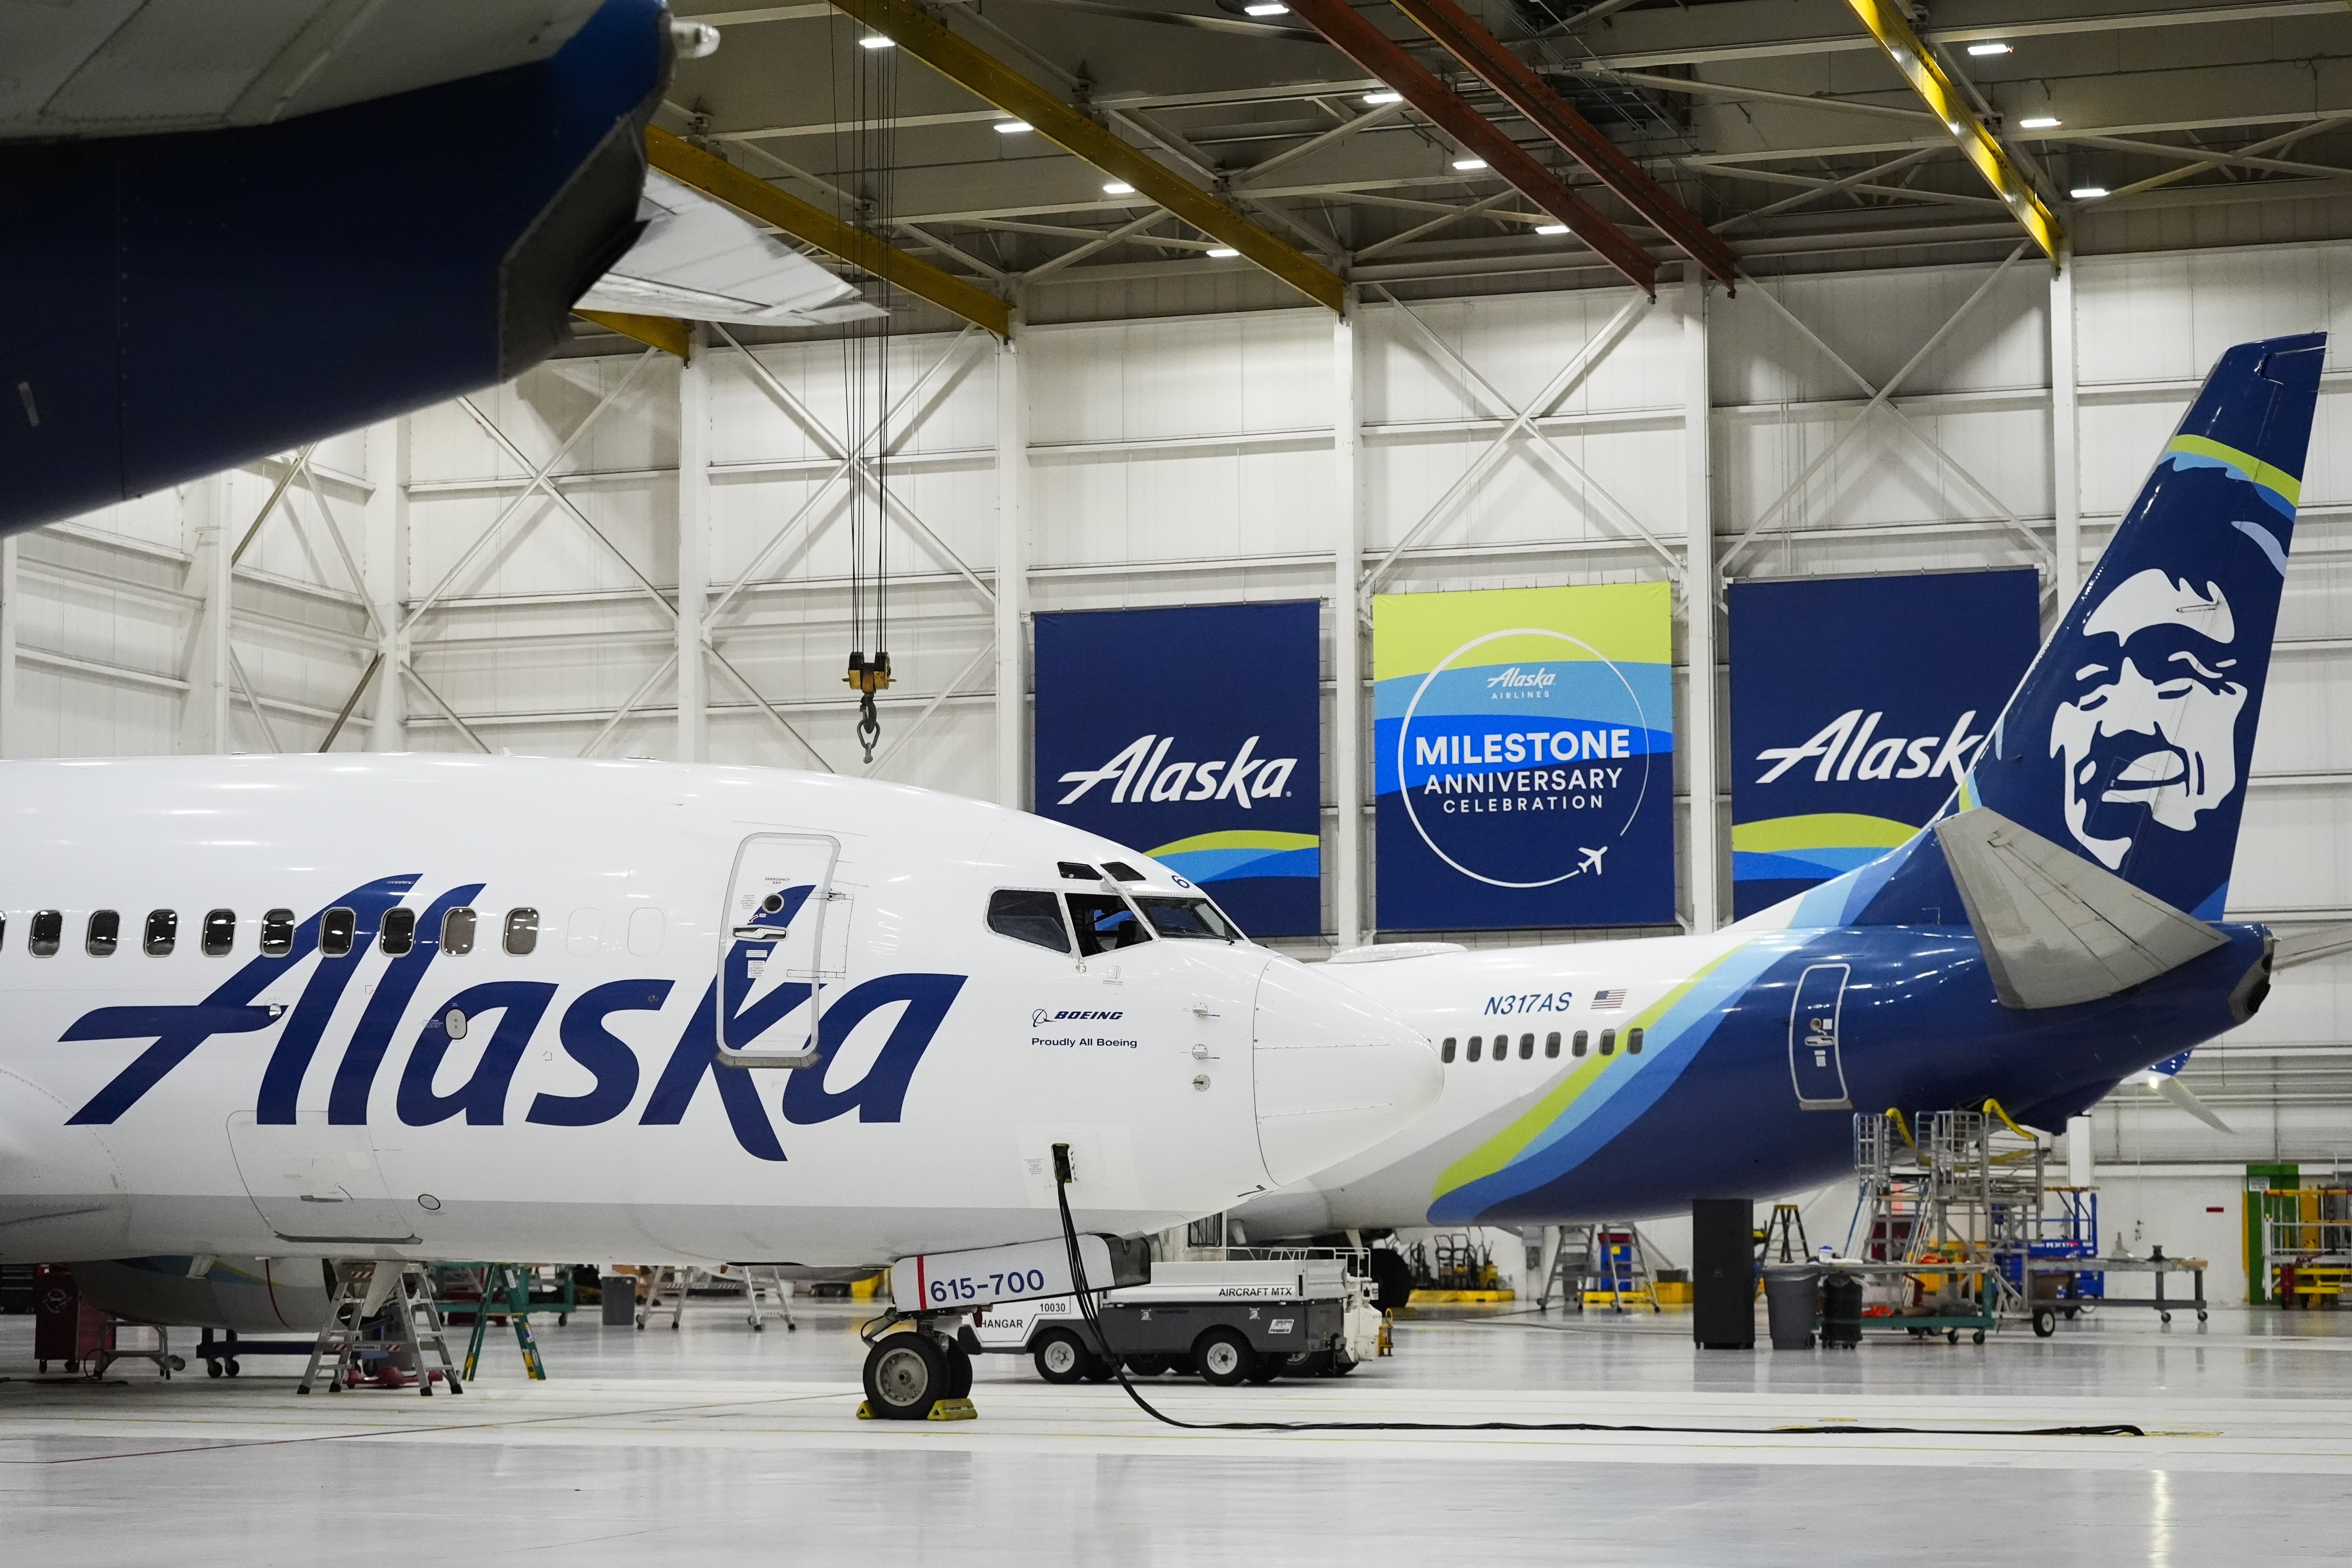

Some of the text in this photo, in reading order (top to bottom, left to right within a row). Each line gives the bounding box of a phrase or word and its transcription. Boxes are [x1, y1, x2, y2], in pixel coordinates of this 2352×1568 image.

[1487, 667, 1557, 689] Alaska
[1491, 690, 1550, 699] AIRLINES
[1416, 729, 1630, 765] MILESTONE
[1756, 709, 1985, 785] Alask
[1057, 734, 1298, 809] Alaska
[1424, 768, 1623, 795] ANNIVERSARY
[1443, 795, 1603, 814] CELEBRATION
[1484, 991, 1572, 1015] N317AS
[57, 874, 969, 1162] Alaska
[1054, 1011, 1123, 1020] BOEING
[1031, 1038, 1076, 1048] Proudly
[1096, 1038, 1137, 1049] Boeing
[930, 1269, 1044, 1302] 615-700
[1218, 1287, 1292, 1297] AIRCRAFT MTX
[1039, 1303, 1066, 1312] 10030
[981, 1319, 1023, 1328] HANGAR
